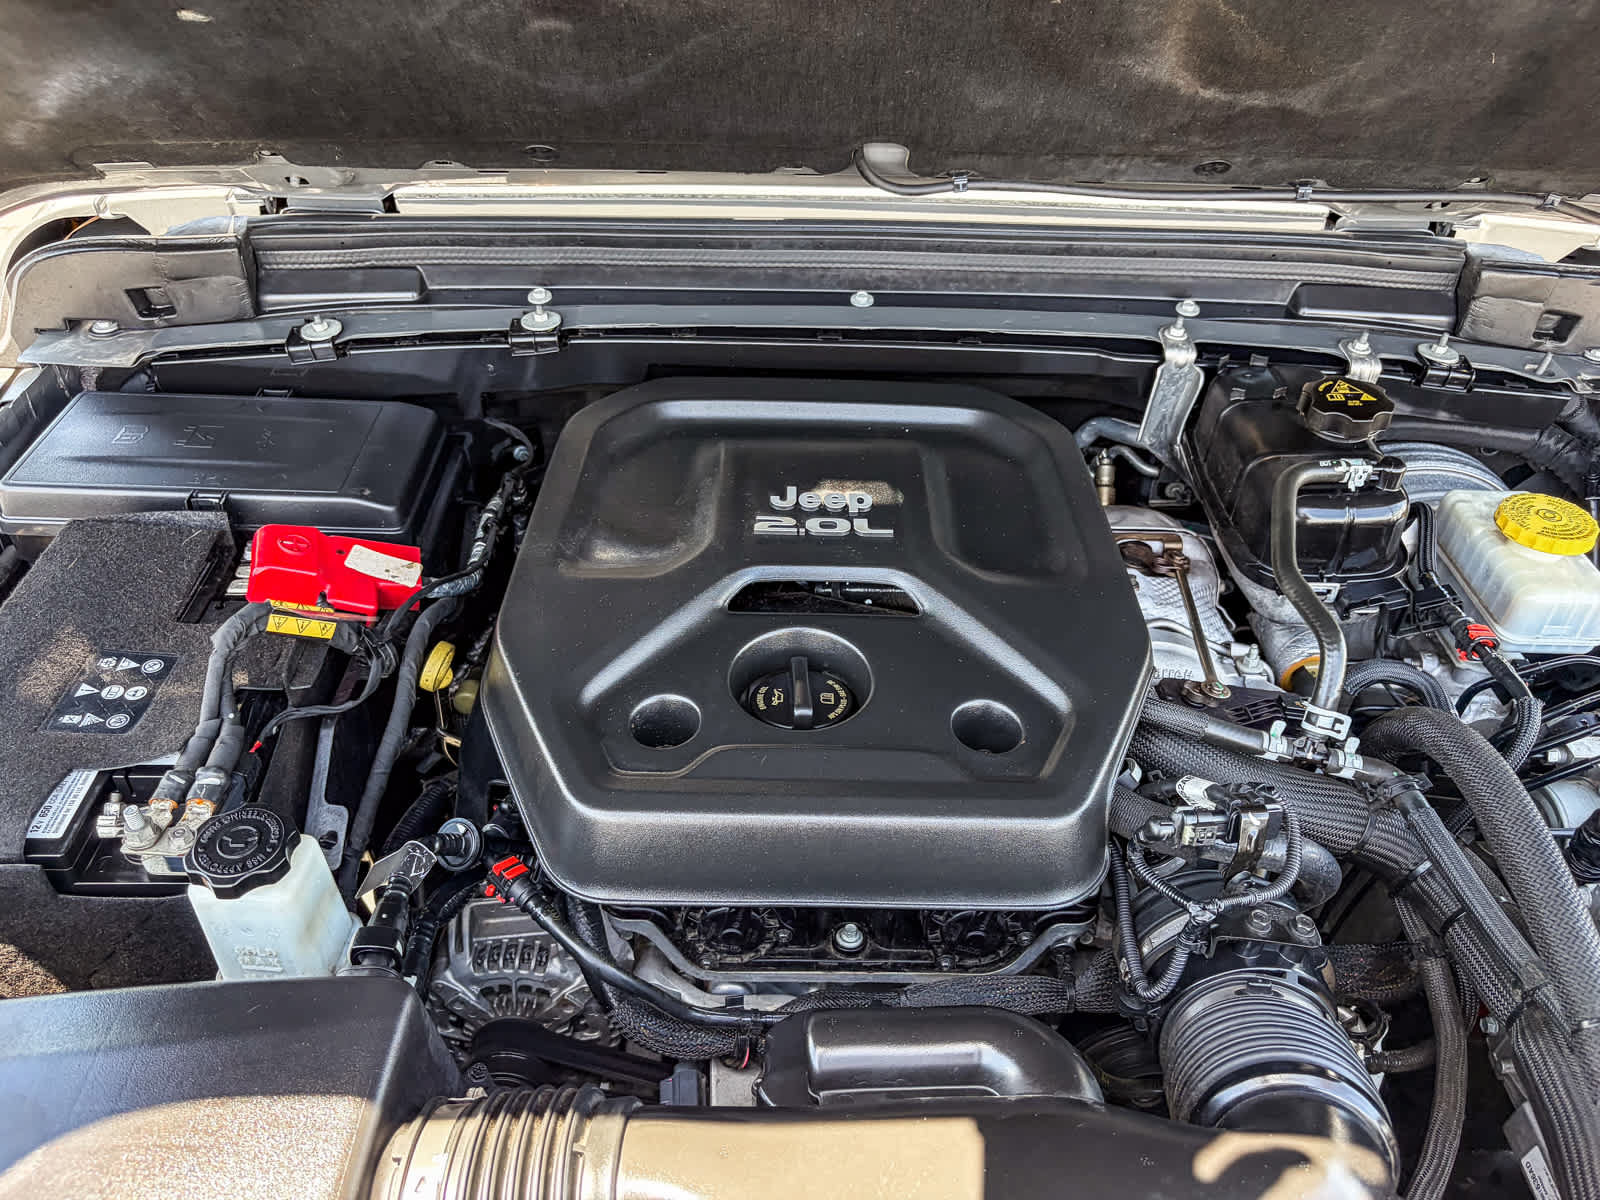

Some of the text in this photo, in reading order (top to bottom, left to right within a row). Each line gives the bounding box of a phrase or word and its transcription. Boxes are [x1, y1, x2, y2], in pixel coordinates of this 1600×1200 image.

[769, 485, 873, 516] Jeep
[753, 515, 895, 537] 2.0L
[1152, 668, 1193, 680] arrett
[38, 805, 53, 818] 650
